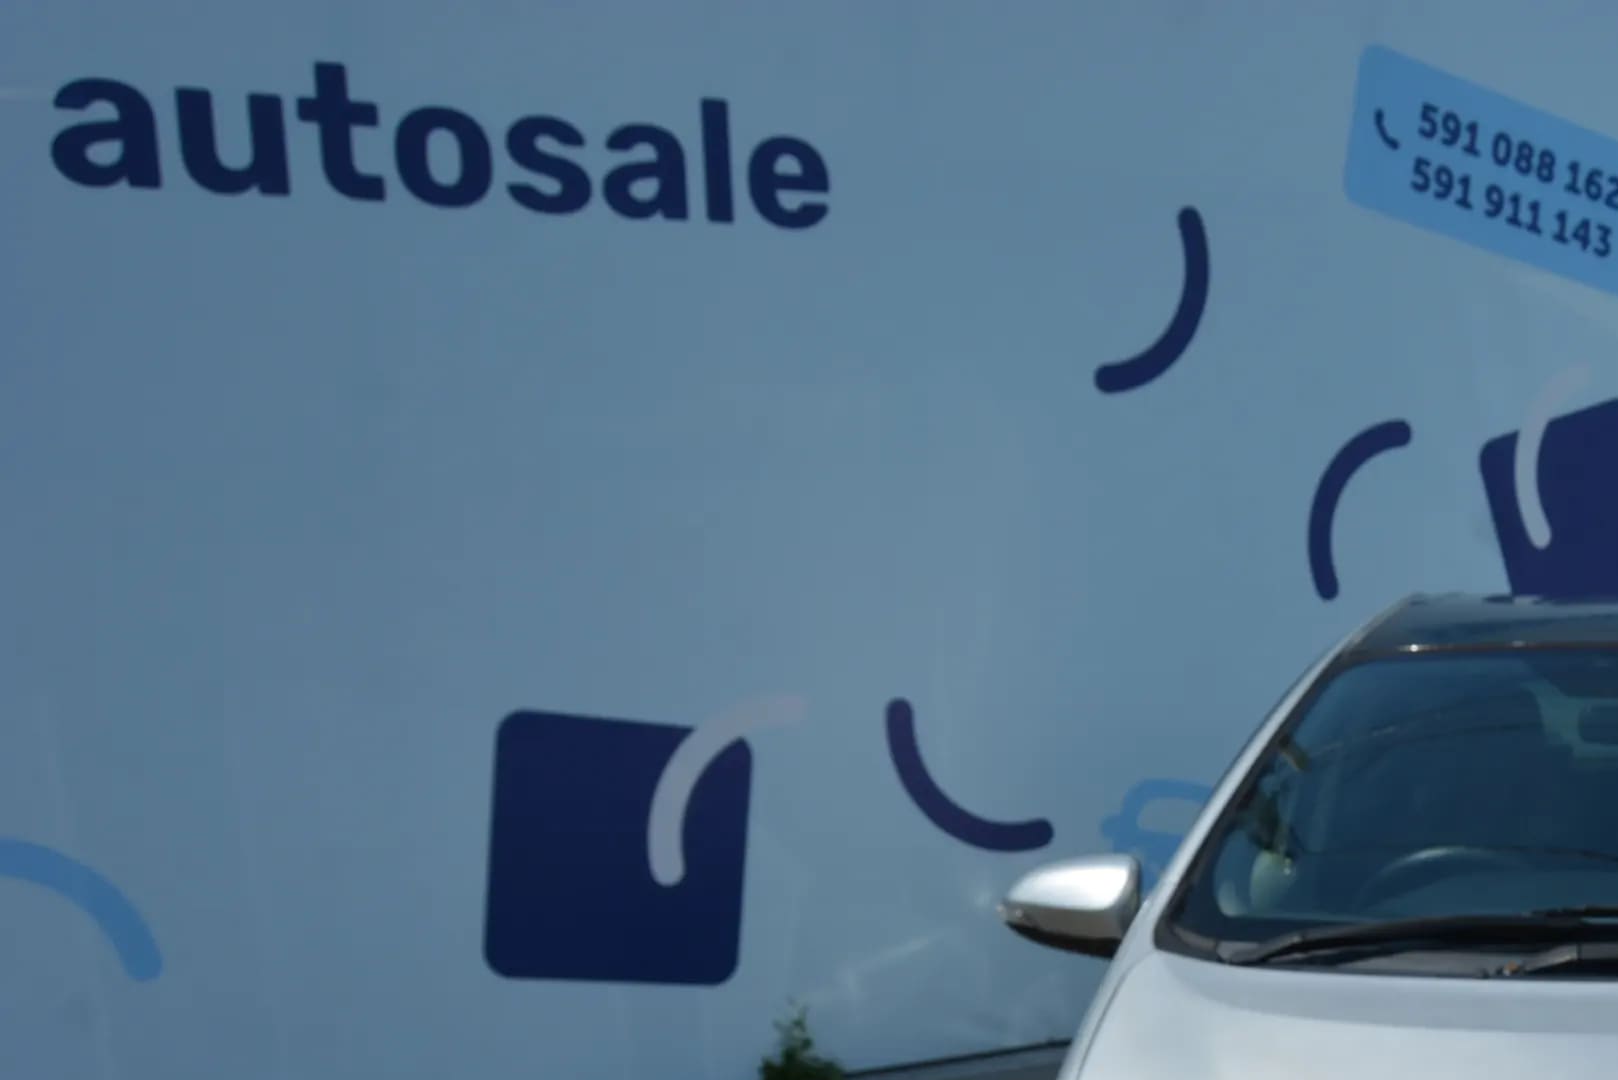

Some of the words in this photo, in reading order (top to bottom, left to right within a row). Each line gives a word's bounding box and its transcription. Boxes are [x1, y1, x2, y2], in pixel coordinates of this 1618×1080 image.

[51, 61, 831, 229] autosale
[1418, 102, 1481, 157] 591
[1492, 131, 1556, 183] 088
[1411, 156, 1473, 210] 591
[1484, 184, 1542, 236] 911
[1552, 210, 1612, 257] 143
